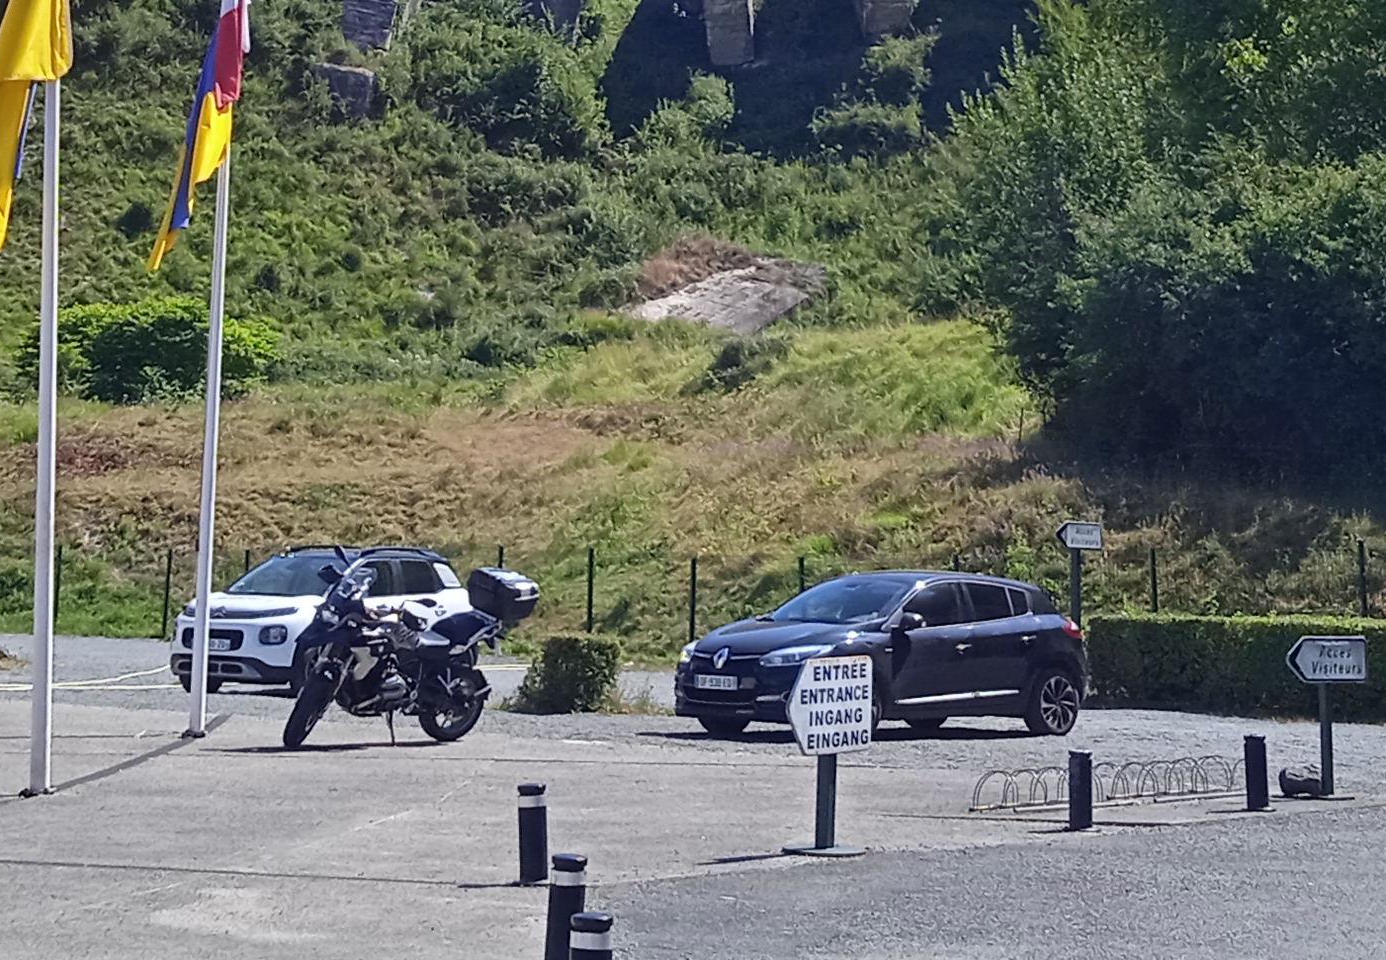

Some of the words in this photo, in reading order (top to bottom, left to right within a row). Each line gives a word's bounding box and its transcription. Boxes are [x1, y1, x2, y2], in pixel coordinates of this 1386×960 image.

[813, 659, 867, 682] ENTRÉE
[1312, 661, 1362, 675] Visiteurs
[800, 685, 869, 705] ENTRANCE
[809, 707, 863, 727] INGANG
[807, 729, 869, 749] EINGANG
